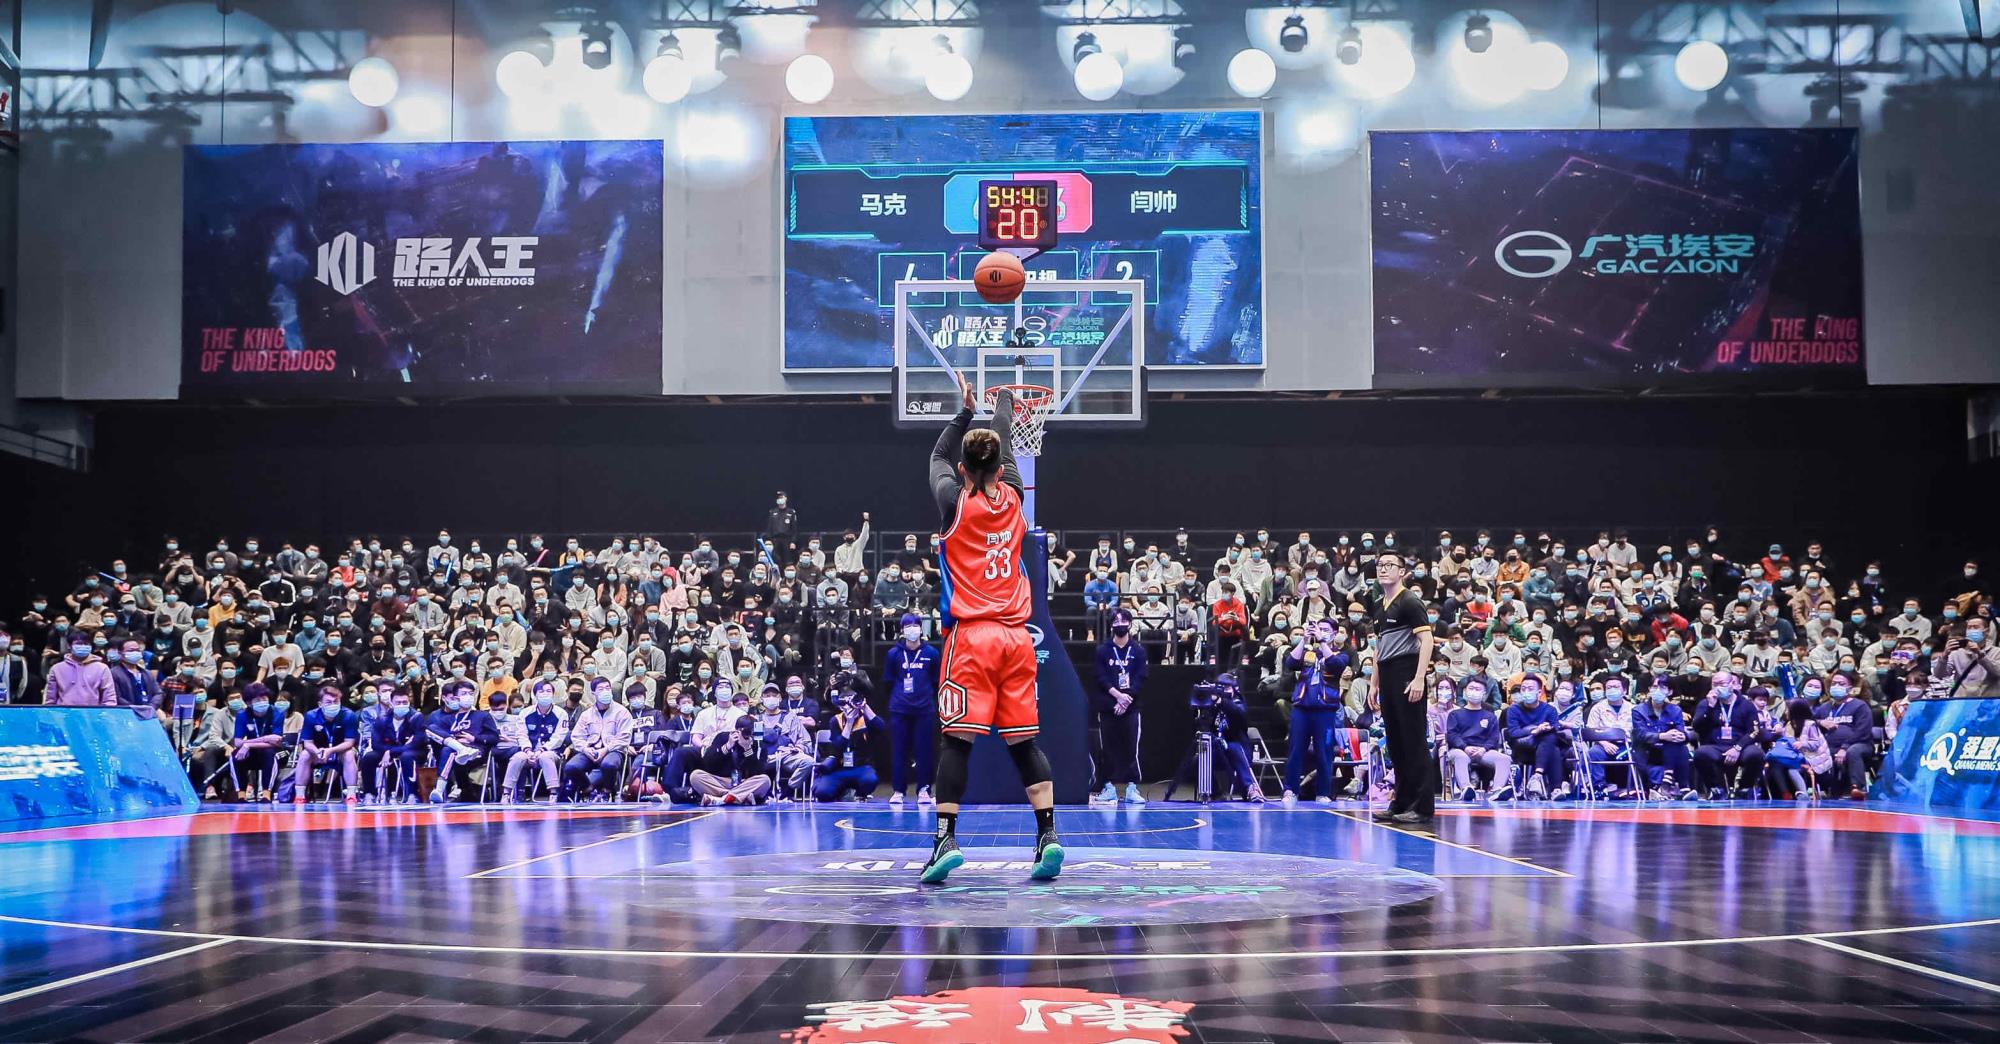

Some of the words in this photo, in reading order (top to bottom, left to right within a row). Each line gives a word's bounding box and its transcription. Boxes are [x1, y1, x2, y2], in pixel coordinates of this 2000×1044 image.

[860, 193, 907, 216] 马克
[1131, 190, 1177, 213] 闫帅
[998, 208, 1038, 240] 20
[1578, 234, 1755, 257] 广汽埃安
[393, 237, 539, 278] 路人王
[1596, 259, 1659, 274] GAC
[1663, 259, 1738, 274] AION
[393, 278, 414, 288] THE
[418, 278, 445, 287] KING
[449, 278, 463, 287] OF
[466, 277, 535, 286] UNDERDOGS
[202, 328, 237, 350] THE
[243, 327, 286, 350] KING
[1771, 318, 1806, 340] THE
[1814, 317, 1858, 340] KING
[200, 350, 227, 372] OF
[231, 350, 336, 372] UNDERDOGS
[1717, 341, 1744, 363] OF
[1750, 341, 1858, 364] UNDERDOGS
[985, 547, 1012, 580] 33
[1959, 736, 2000, 760] 强盟
